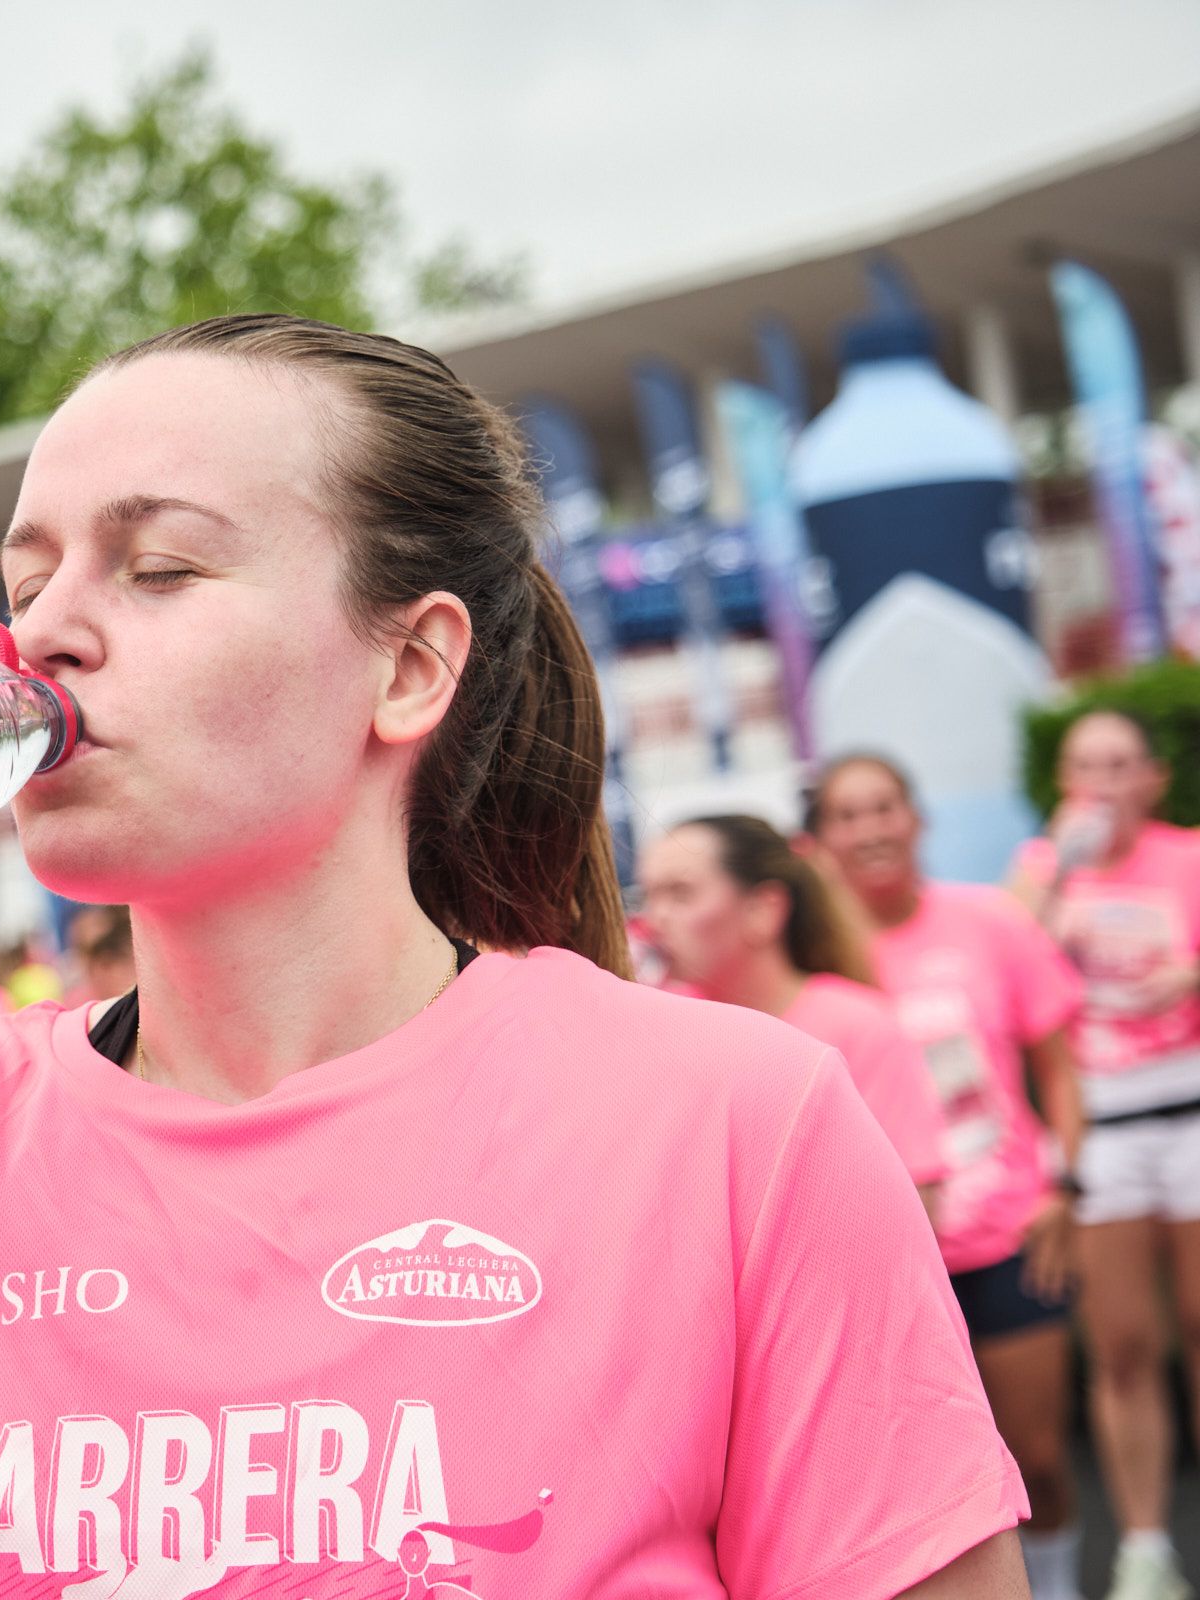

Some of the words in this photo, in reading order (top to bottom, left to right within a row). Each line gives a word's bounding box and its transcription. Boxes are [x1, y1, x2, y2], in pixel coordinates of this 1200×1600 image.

[373, 1253, 441, 1270] CENTRAL
[448, 1255, 519, 1271] LECHERA
[336, 1263, 525, 1303] ASTURIANA
